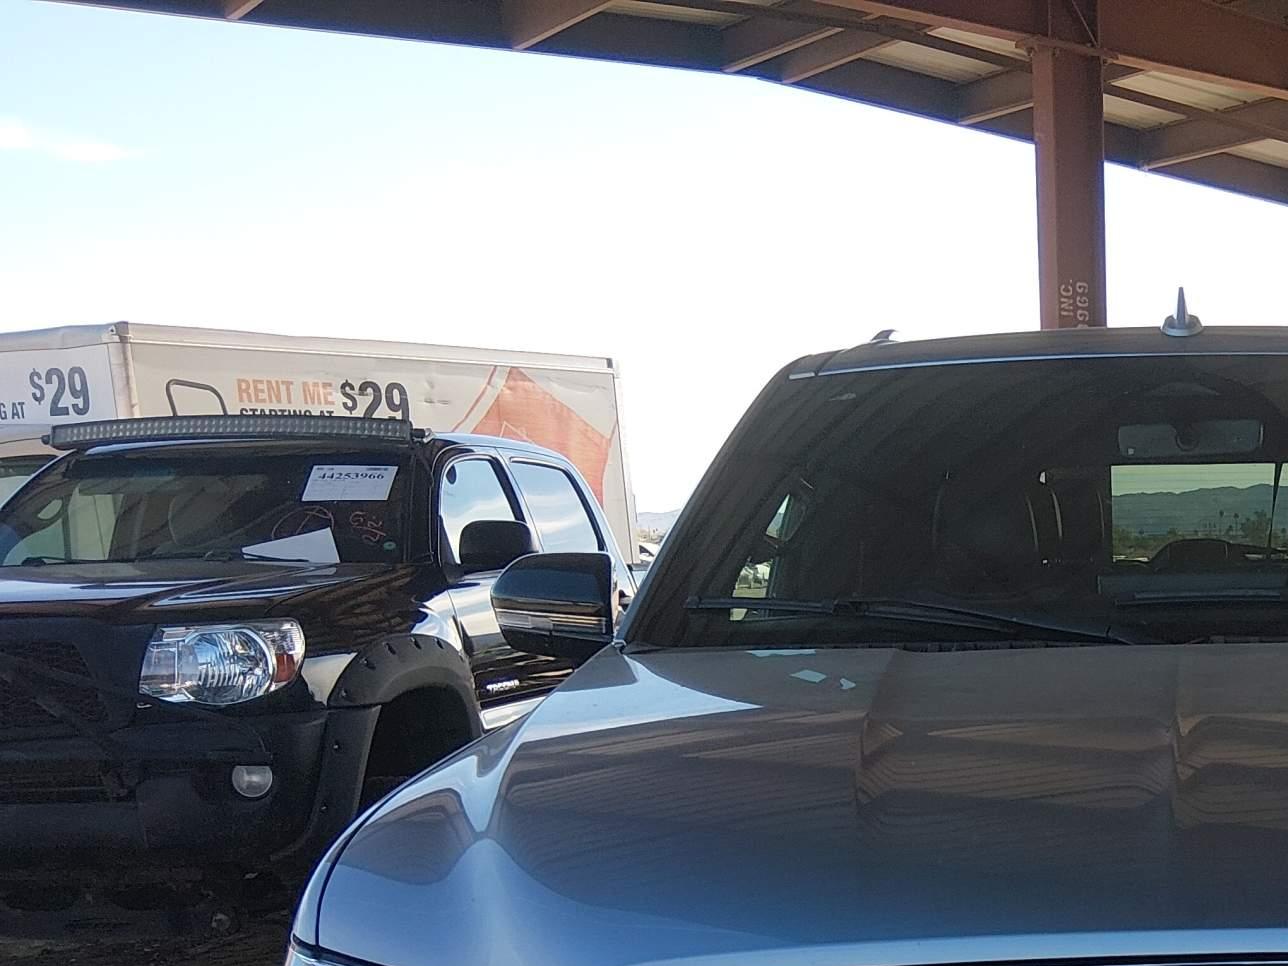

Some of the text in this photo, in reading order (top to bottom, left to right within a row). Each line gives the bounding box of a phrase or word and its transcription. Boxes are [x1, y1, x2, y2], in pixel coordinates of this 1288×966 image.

[1060, 279, 1073, 316] INC.
[29, 366, 91, 417] $29
[237, 378, 335, 406] RENT ME
[340, 379, 410, 421] $29
[11, 401, 25, 419] AT
[319, 472, 385, 480] 44253966
